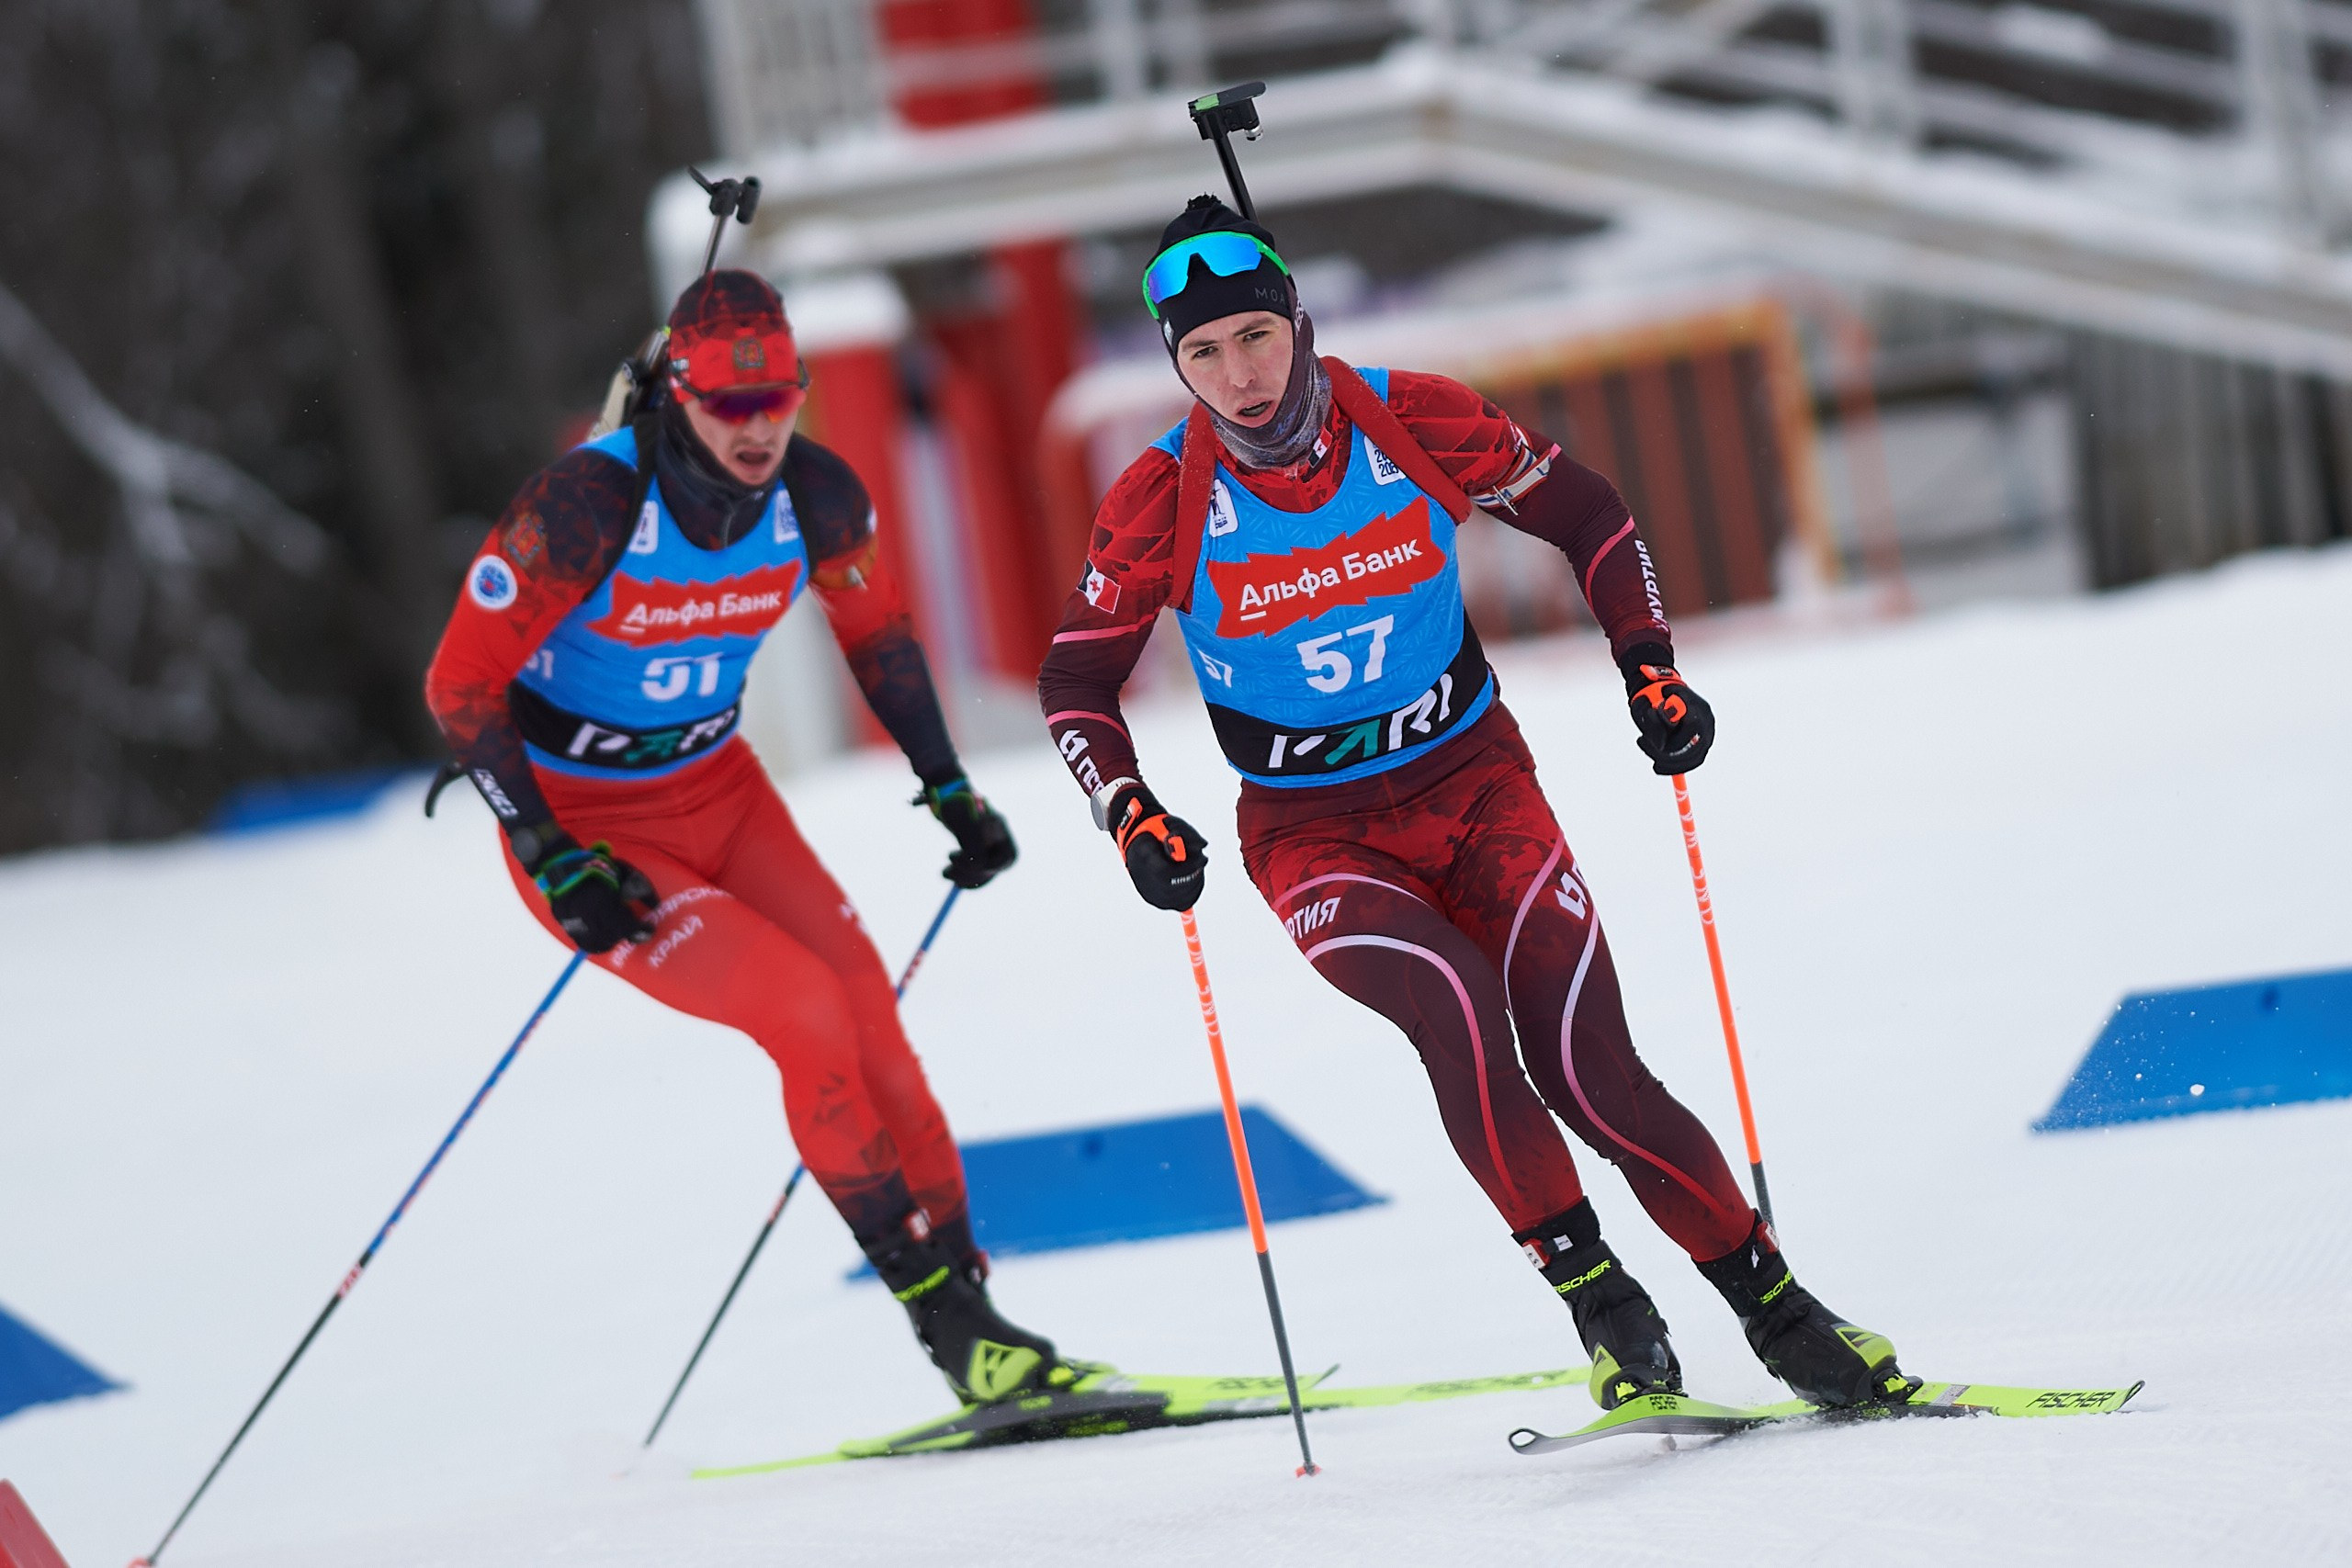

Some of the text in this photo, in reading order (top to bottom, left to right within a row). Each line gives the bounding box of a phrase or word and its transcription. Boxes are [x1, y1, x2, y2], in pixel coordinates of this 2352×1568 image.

[1239, 539, 1423, 612] Альфа Банк
[624, 591, 782, 626] Альфа Банк
[1197, 649, 1233, 688] 57
[1296, 614, 1395, 694] 57
[648, 914, 705, 967] КРАЙ
[2025, 1390, 2118, 1409] FISCHER
